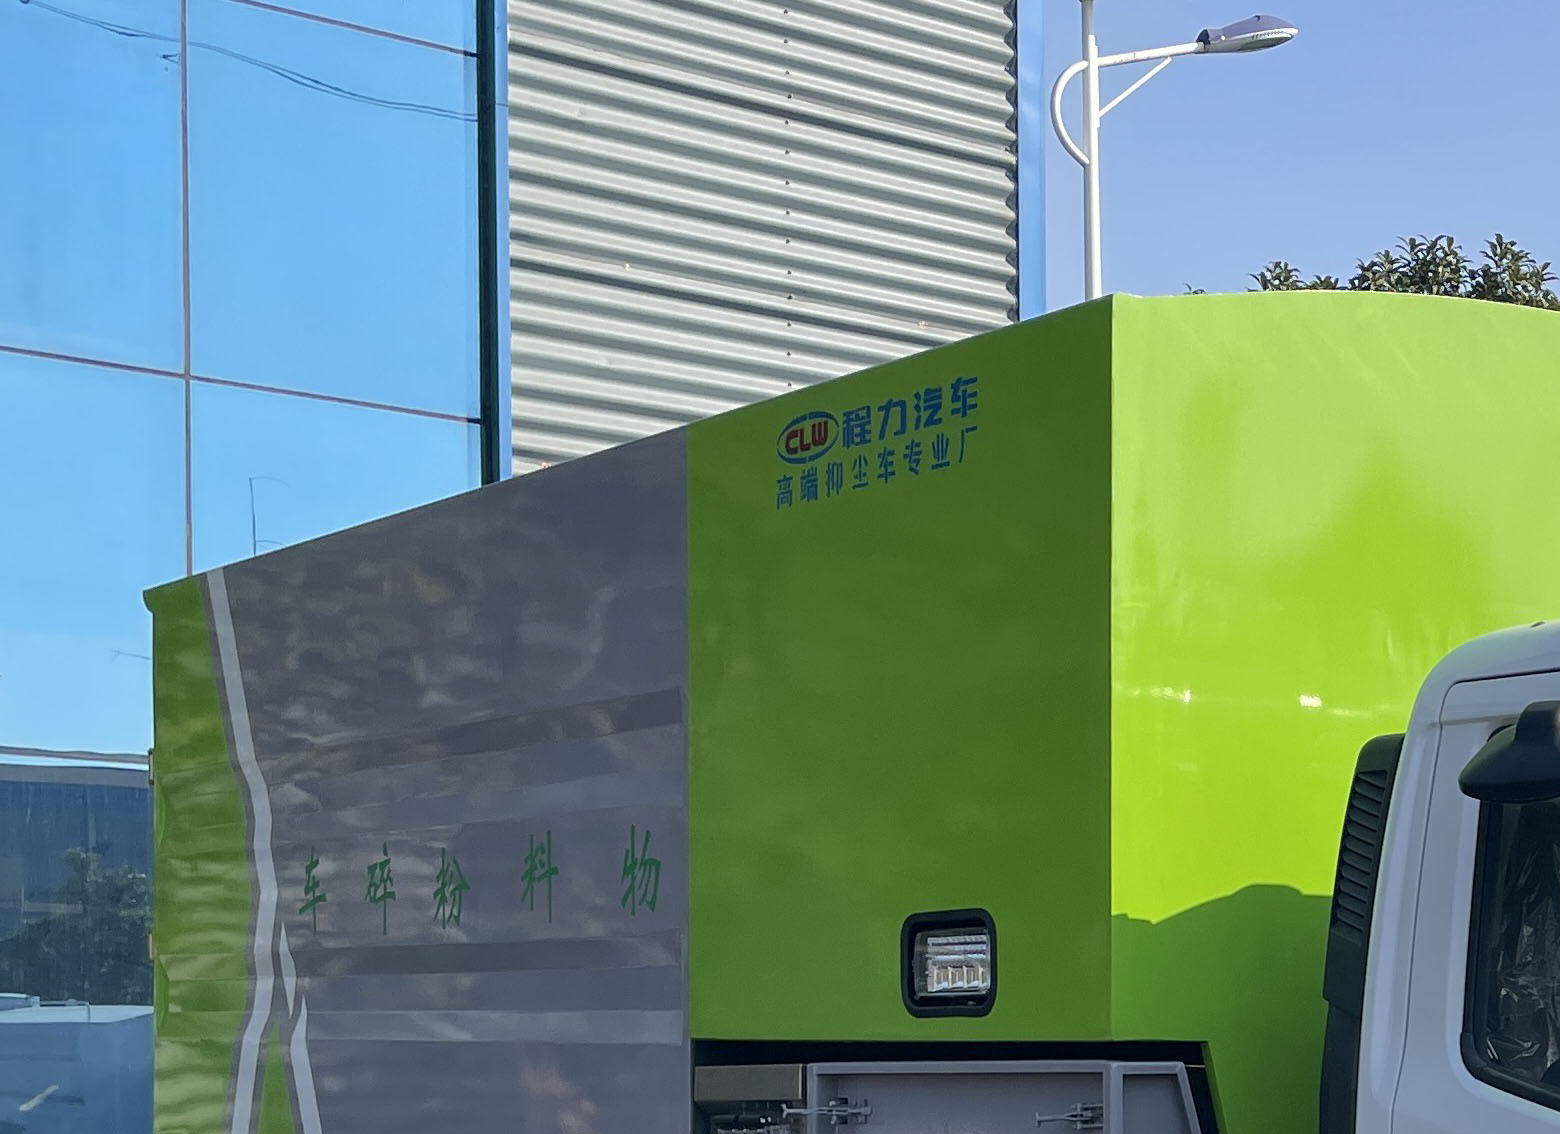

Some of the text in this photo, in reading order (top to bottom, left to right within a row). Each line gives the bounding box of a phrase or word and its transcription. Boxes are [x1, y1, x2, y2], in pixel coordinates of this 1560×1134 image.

[785, 377, 978, 455] CLW 程力汽车
[776, 426, 978, 510] 高端抑尘车专业厂
